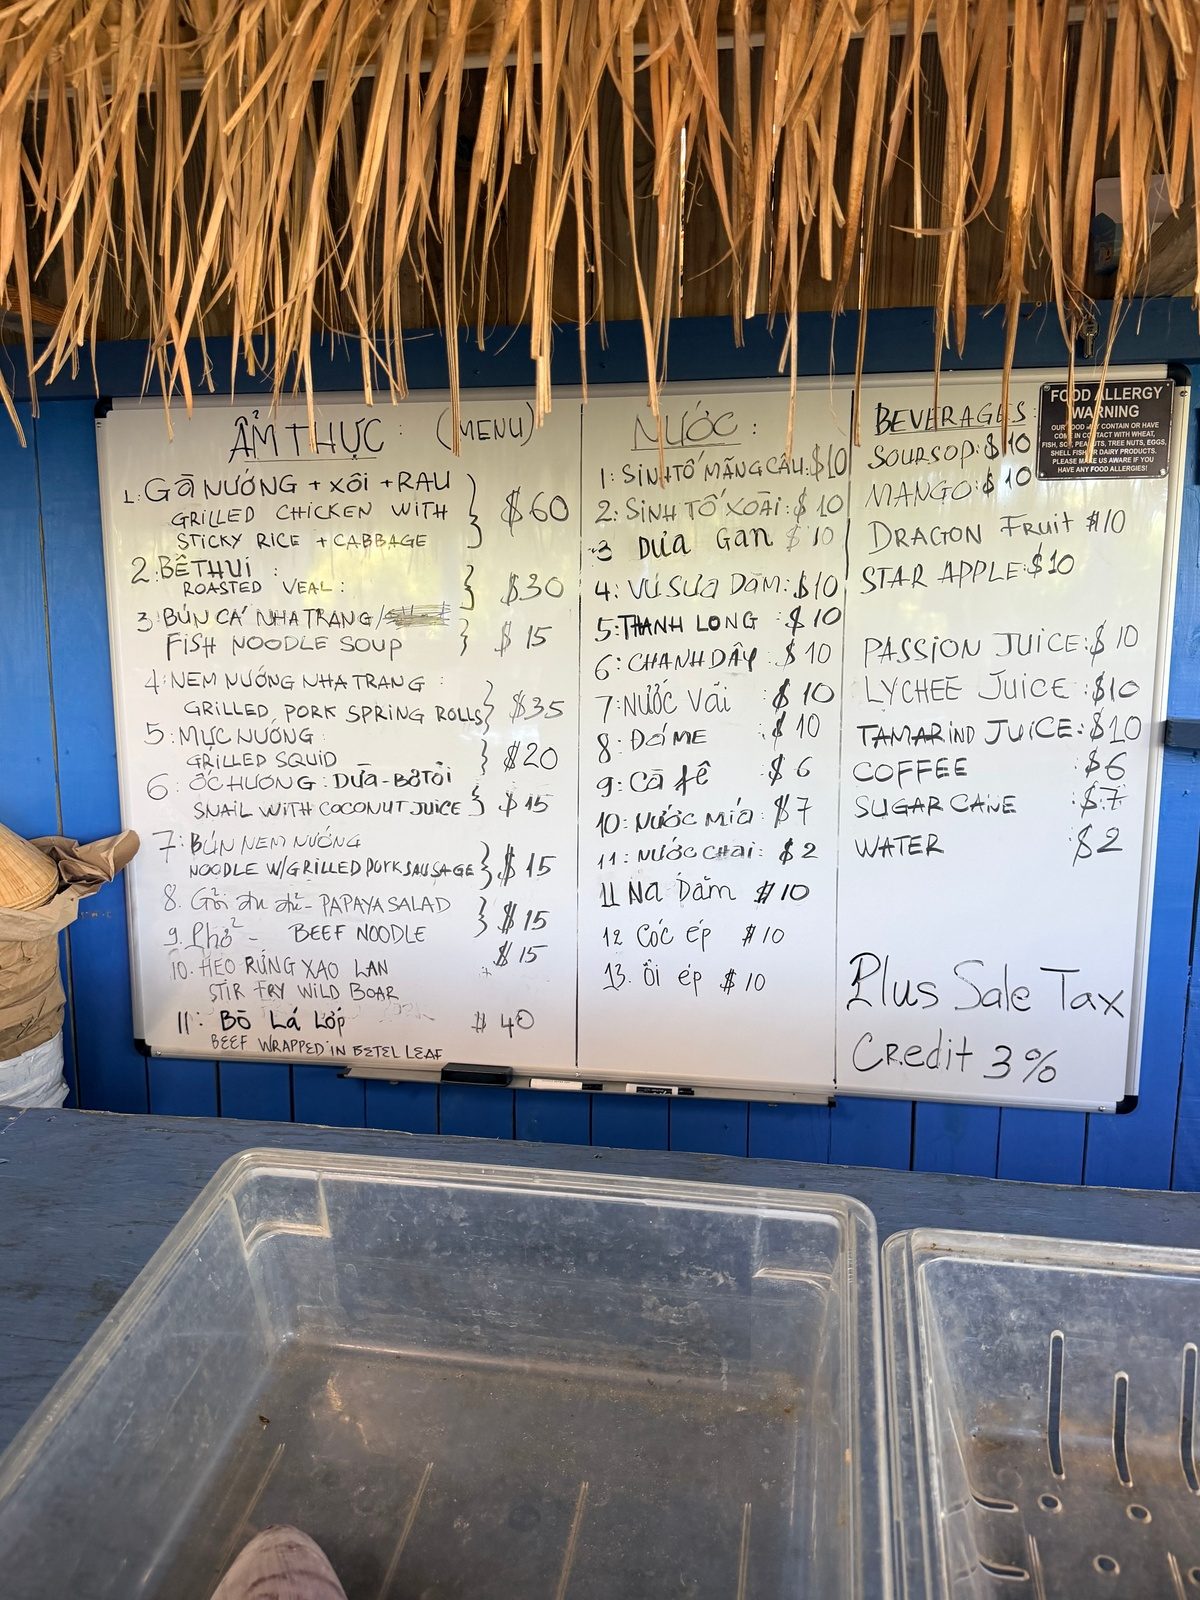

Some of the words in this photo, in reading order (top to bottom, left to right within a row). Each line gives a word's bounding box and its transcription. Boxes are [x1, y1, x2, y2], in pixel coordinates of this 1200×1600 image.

[1050, 388, 1091, 402] FOOD
[1094, 386, 1163, 401] ALLERGY
[1072, 405, 1140, 419] WARNING
[1131, 421, 1141, 429] OR
[1142, 421, 1160, 429] HAVE
[1050, 449, 1071, 457] SHELL
[1099, 448, 1119, 456] DAIRY
[1108, 439, 1125, 447] TREE
[1090, 465, 1108, 473] FOOD
[1109, 464, 1148, 472] ALLERGIES!
[1108, 456, 1132, 464] AWARE
[868, 520, 982, 555] DRAGON
[183, 580, 262, 597] ROASTED
[500, 572, 564, 606] $30
[861, 563, 928, 595] STAR
[696, 611, 759, 632] LONG
[232, 635, 329, 659] NOODLE
[340, 635, 403, 661] SOUP
[170, 670, 217, 689] NEM
[865, 674, 963, 705] LYCHEE
[284, 703, 338, 723] PORK
[435, 705, 484, 726] ROLLS
[509, 690, 565, 724] $35
[503, 740, 559, 772] $20
[852, 756, 968, 790] COFFEE
[855, 794, 943, 818] SUGAR
[854, 832, 945, 859] WATER
[189, 861, 259, 879] NOODLE
[319, 893, 384, 917] PAPAYA
[388, 895, 452, 914] SALAD
[288, 923, 346, 943] BEEF
[356, 923, 427, 944] NOODLE
[354, 958, 389, 979] LAN
[349, 983, 400, 1001] BOAR
[846, 951, 940, 1011] Plus
[953, 959, 1032, 1012] Sale
[1040, 966, 1125, 1019] Tax
